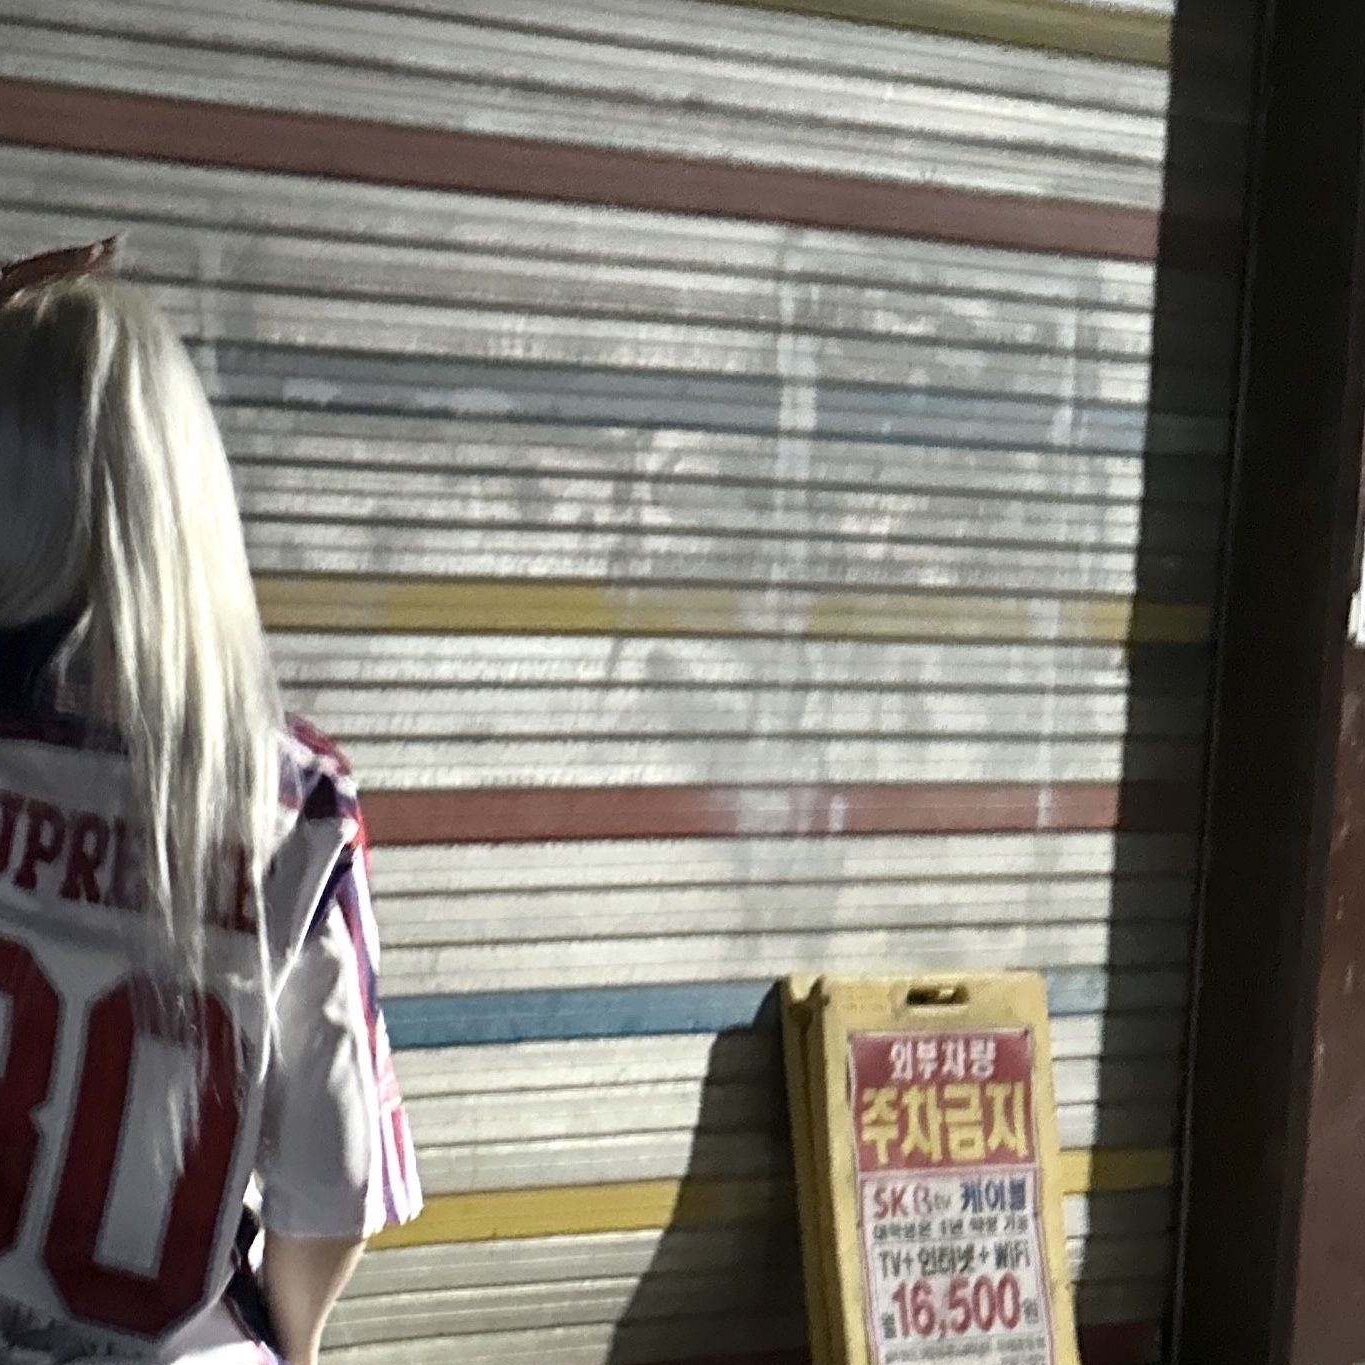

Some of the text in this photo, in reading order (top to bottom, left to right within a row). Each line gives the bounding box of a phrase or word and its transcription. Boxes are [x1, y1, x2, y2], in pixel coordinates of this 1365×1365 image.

[890, 1038, 997, 1081] 외부차량
[861, 1083, 1029, 1165] 주차금지
[873, 1185, 909, 1219] SK
[892, 1272, 1021, 1339] 16,500
